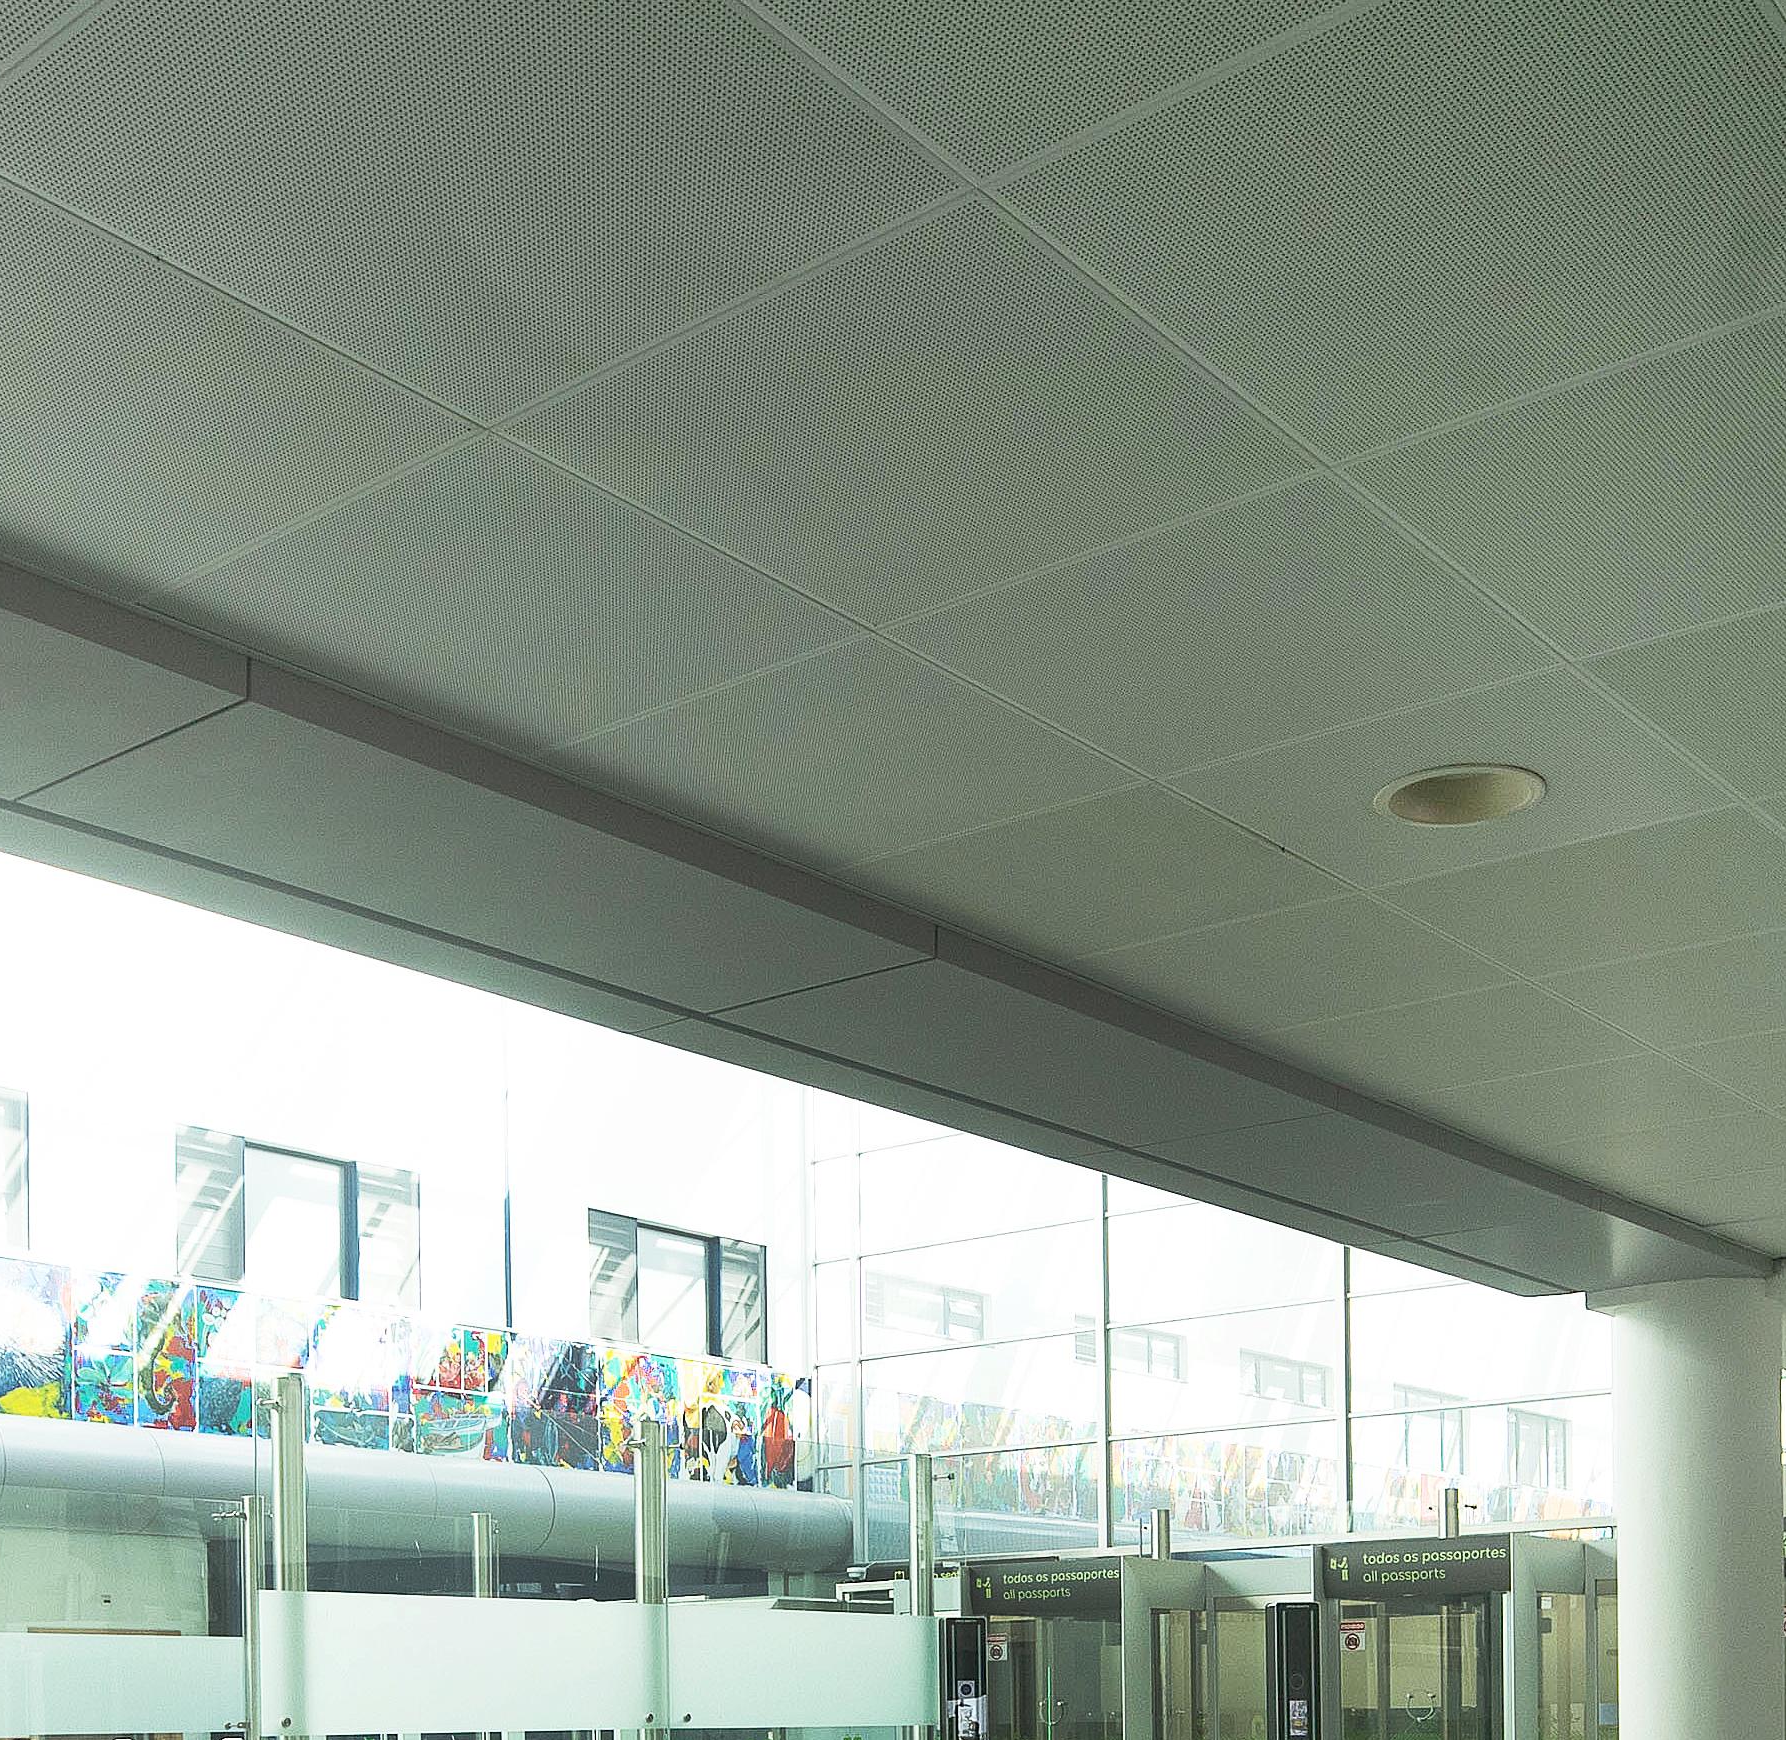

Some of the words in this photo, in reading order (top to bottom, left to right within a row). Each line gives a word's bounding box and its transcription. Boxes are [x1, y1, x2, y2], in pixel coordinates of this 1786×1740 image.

[1363, 1551, 1399, 1565] todos
[1403, 1551, 1419, 1563] os
[1422, 1546, 1507, 1566] passaportes
[1003, 1570, 1033, 1584] todos
[1035, 1571, 1050, 1583] os
[1051, 1568, 1120, 1583] passaportes
[1363, 1568, 1378, 1583] all
[1381, 1567, 1446, 1584] passports
[1003, 1587, 1017, 1600] all
[1018, 1587, 1072, 1602] passports
